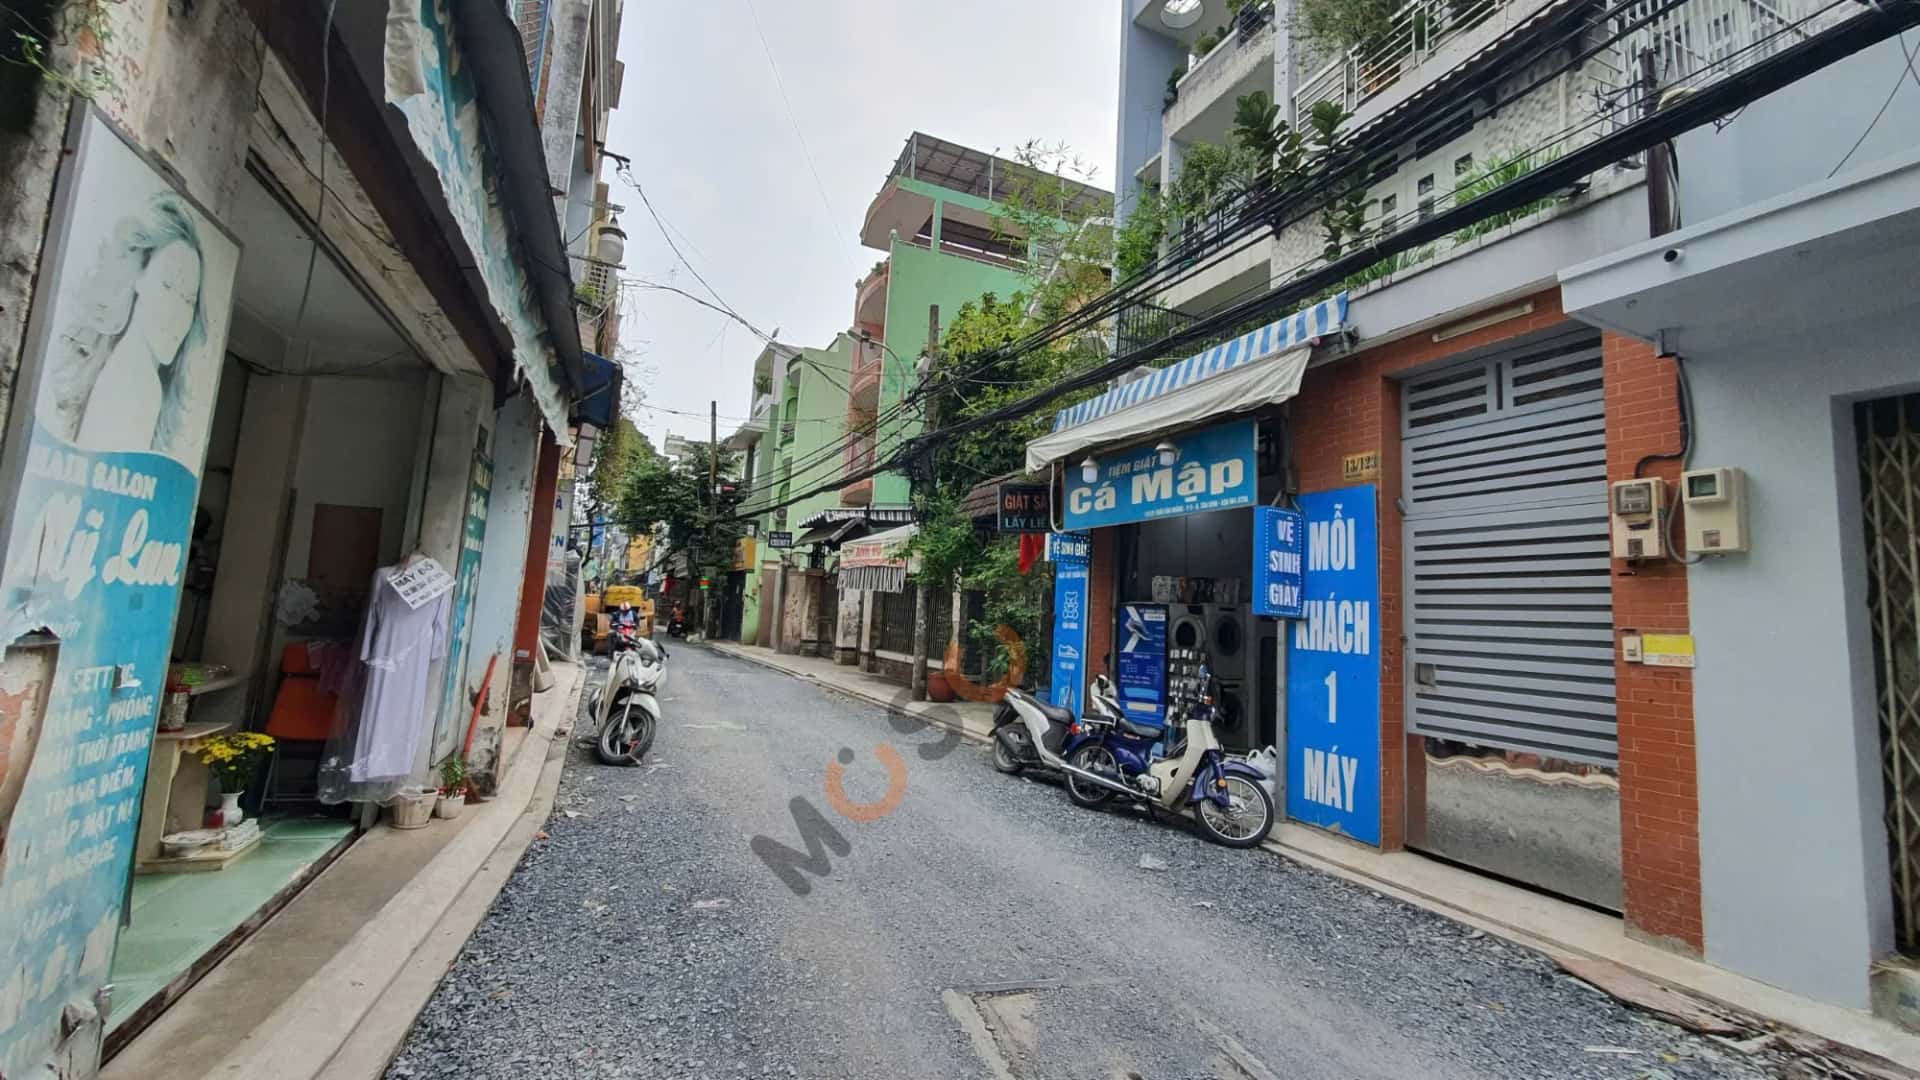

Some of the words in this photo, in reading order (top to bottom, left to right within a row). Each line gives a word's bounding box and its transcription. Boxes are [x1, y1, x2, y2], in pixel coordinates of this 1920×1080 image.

[92, 462, 158, 501] SALON
[1131, 457, 1245, 503] Mập
[1276, 516, 1295, 547] VỆ
[1309, 504, 1356, 571] MỖI
[1269, 549, 1302, 576] SINH
[1269, 580, 1300, 608] GIÀY
[1296, 592, 1370, 656] KHÁCH
[1324, 671, 1337, 723] 1
[1304, 745, 1358, 813] MÁY
